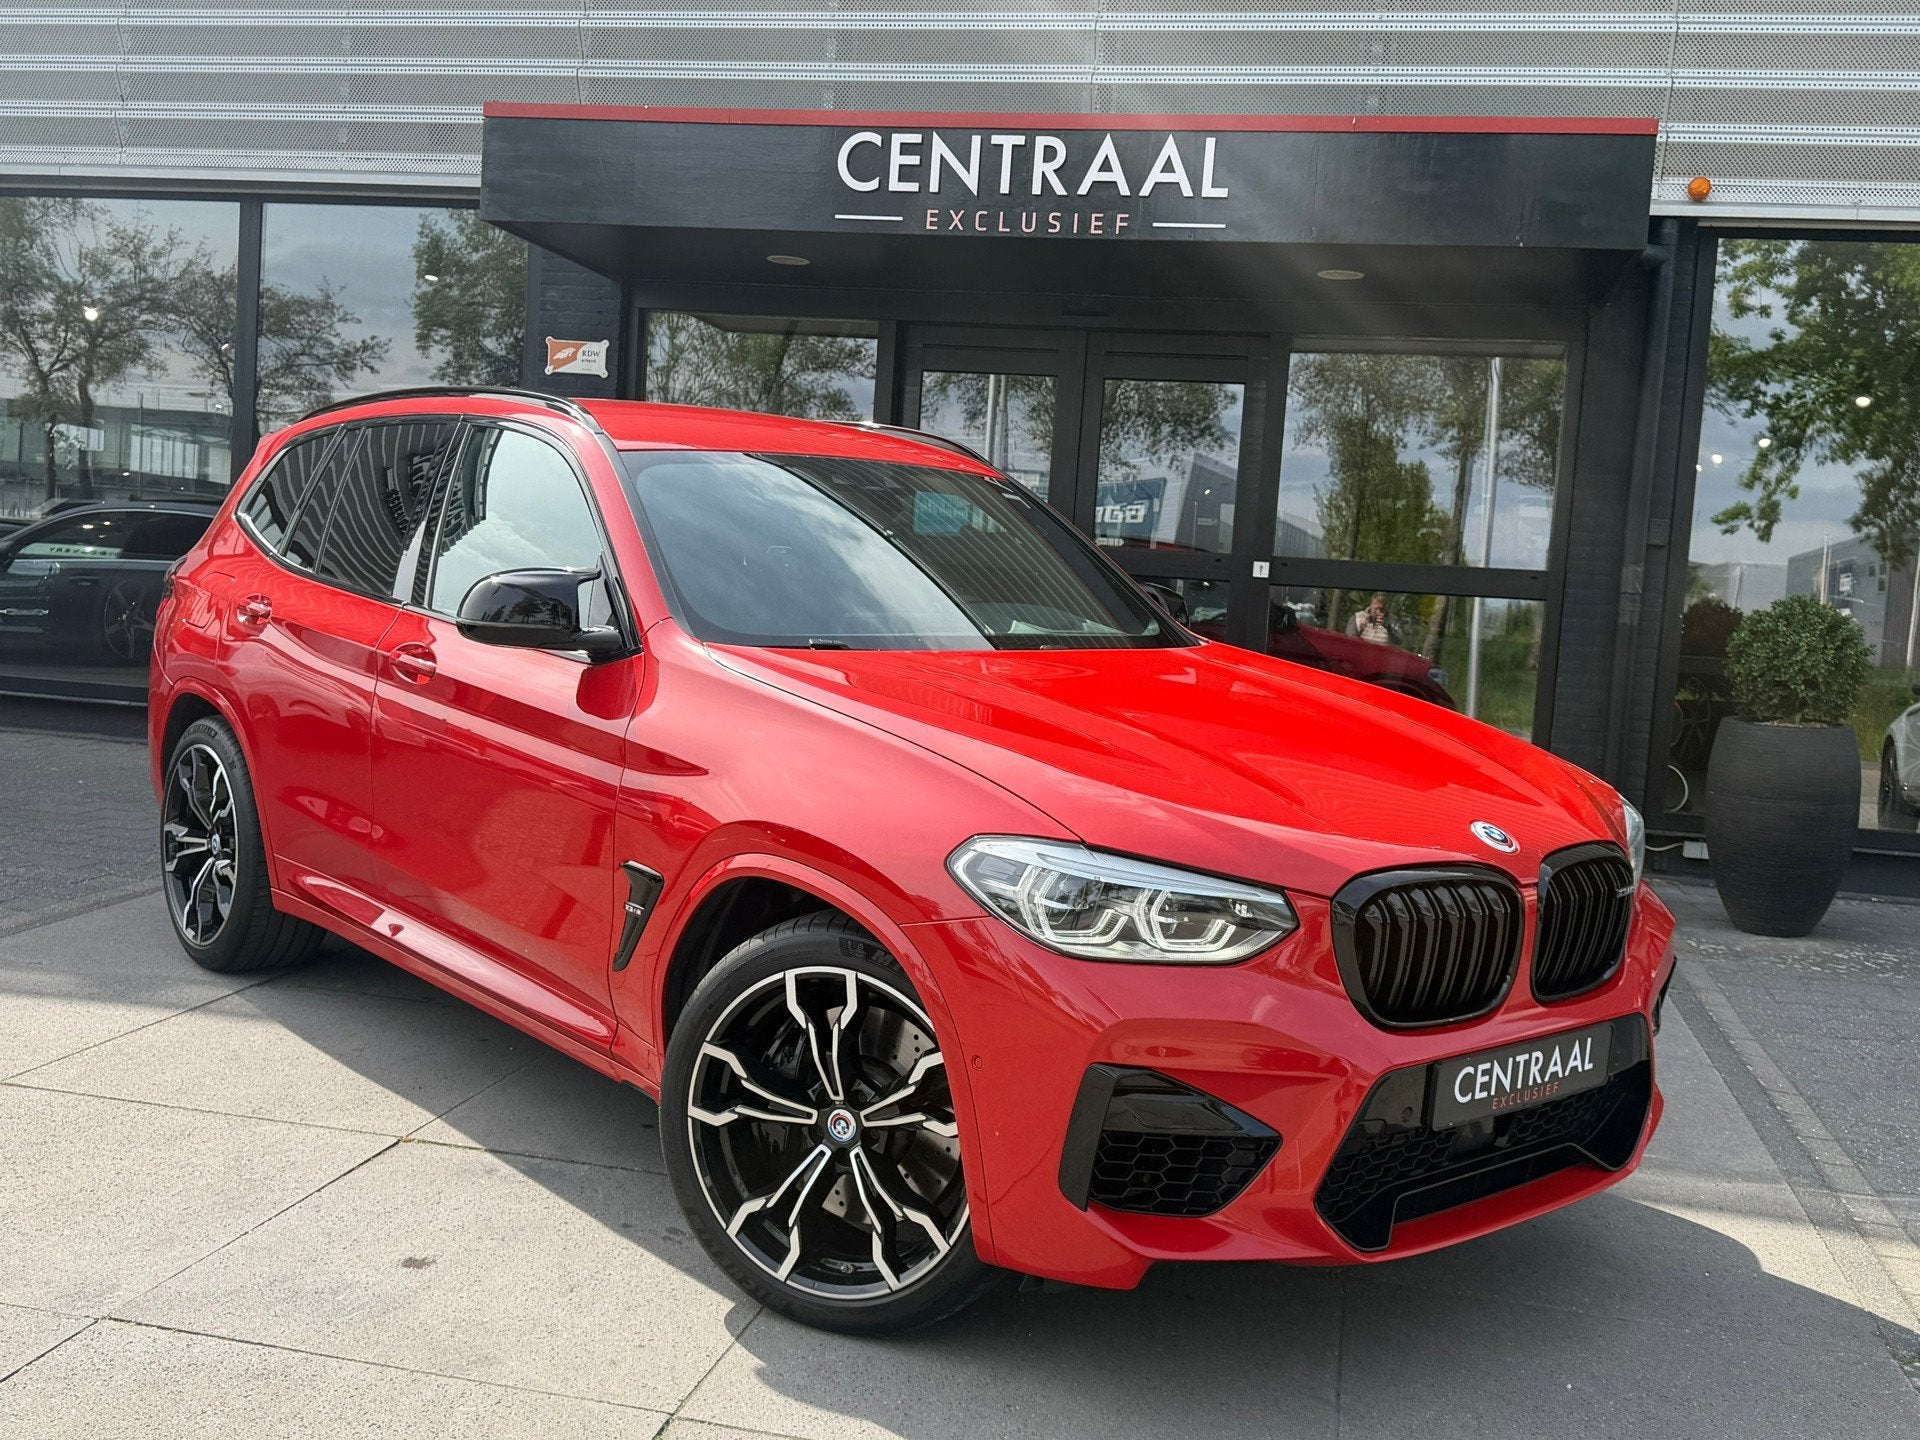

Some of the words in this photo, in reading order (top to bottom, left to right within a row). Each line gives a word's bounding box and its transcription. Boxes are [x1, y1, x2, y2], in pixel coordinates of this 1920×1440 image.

[837, 131, 1229, 198] CENTRAAL
[925, 209, 1130, 235] EXCLUSIEF
[1454, 1037, 1594, 1104] CENTRAAL
[1492, 1082, 1560, 1111] EXCLUSIEF
